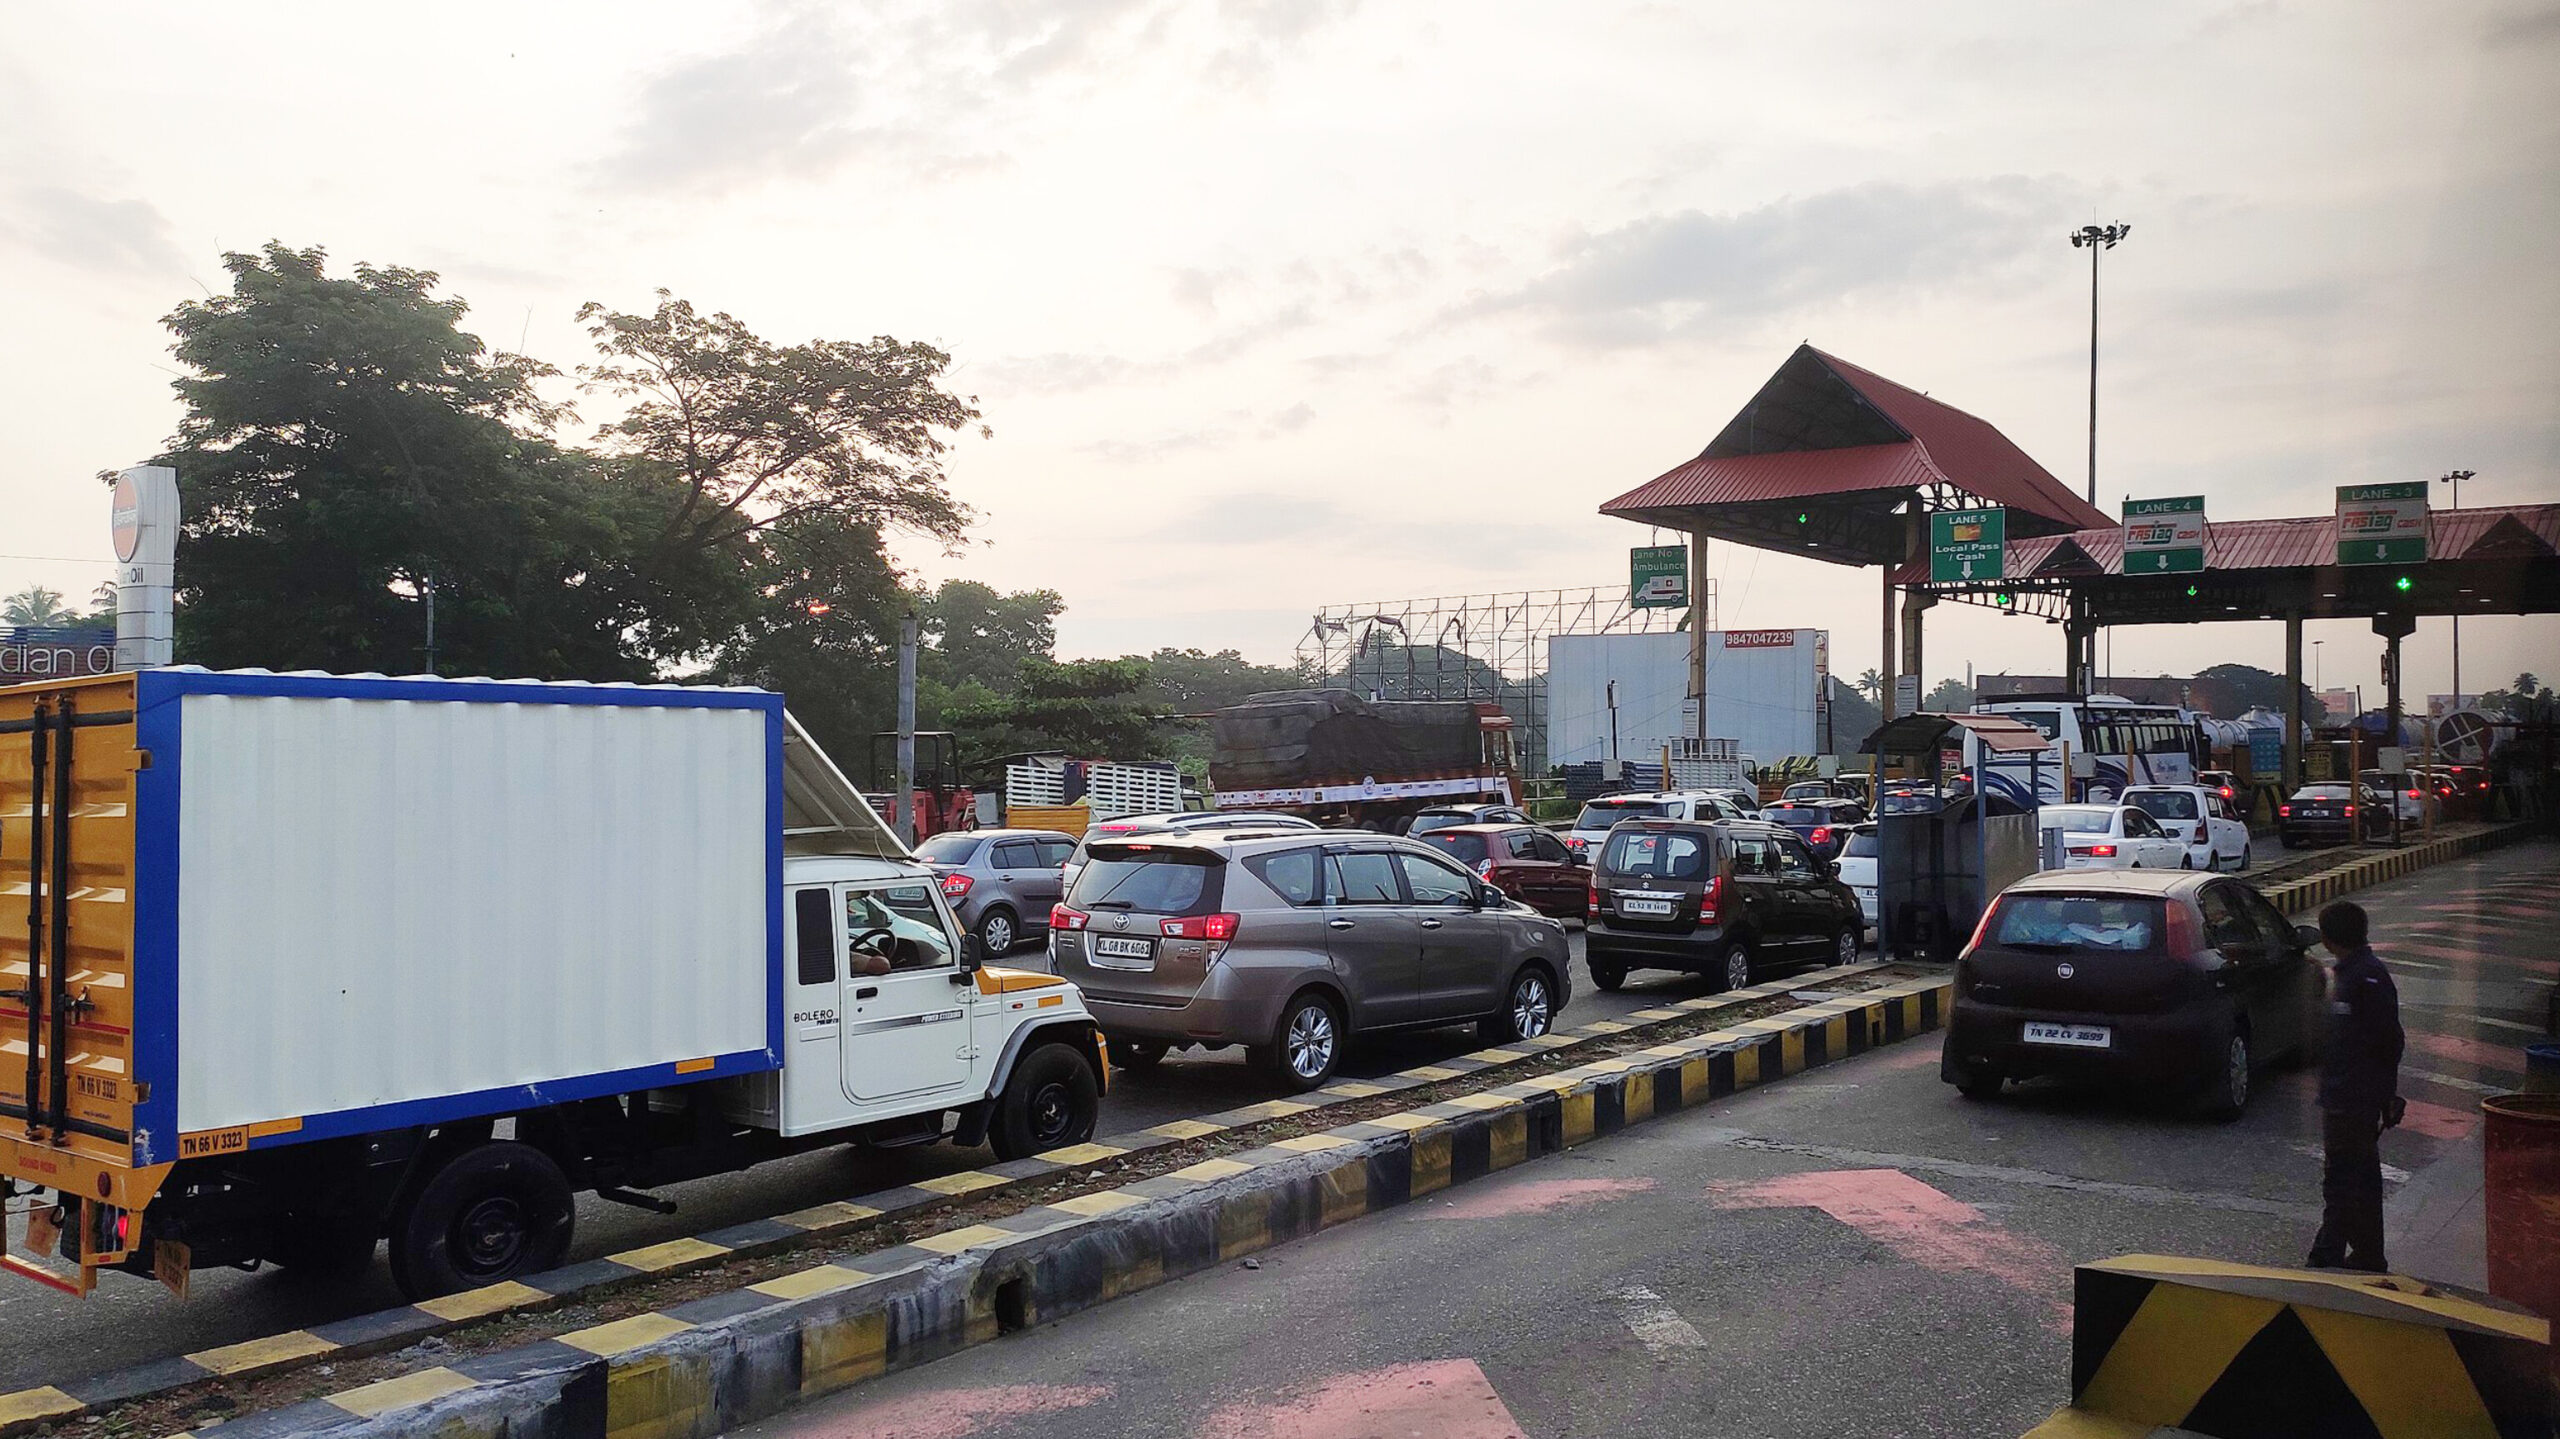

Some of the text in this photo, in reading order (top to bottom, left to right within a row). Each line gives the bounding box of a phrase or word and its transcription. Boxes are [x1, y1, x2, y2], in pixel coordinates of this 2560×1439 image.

[2352, 488, 2392, 500] LANE
[2404, 487, 2413, 497] 3
[2136, 503, 2172, 514] LANE
[2183, 502, 2191, 510] 4
[1949, 515, 1977, 524] LANE
[1632, 550, 1655, 559] Lane
[1657, 549, 1673, 558] No
[1935, 543, 2000, 553] Local Pass
[1956, 552, 1986, 561] Cash
[1632, 562, 1686, 571] Ambulance
[1726, 632, 1793, 645] 9847047239
[1120, 941, 1130, 953] BK
[794, 1009, 834, 1023] BOLERO
[2030, 1028, 2042, 1037] TN
[2045, 1029, 2059, 1038] 22
[2061, 1030, 2074, 1039] CV
[77, 1074, 117, 1100] TN 66 V 3323
[184, 1131, 243, 1155] TN 66 V 3323
